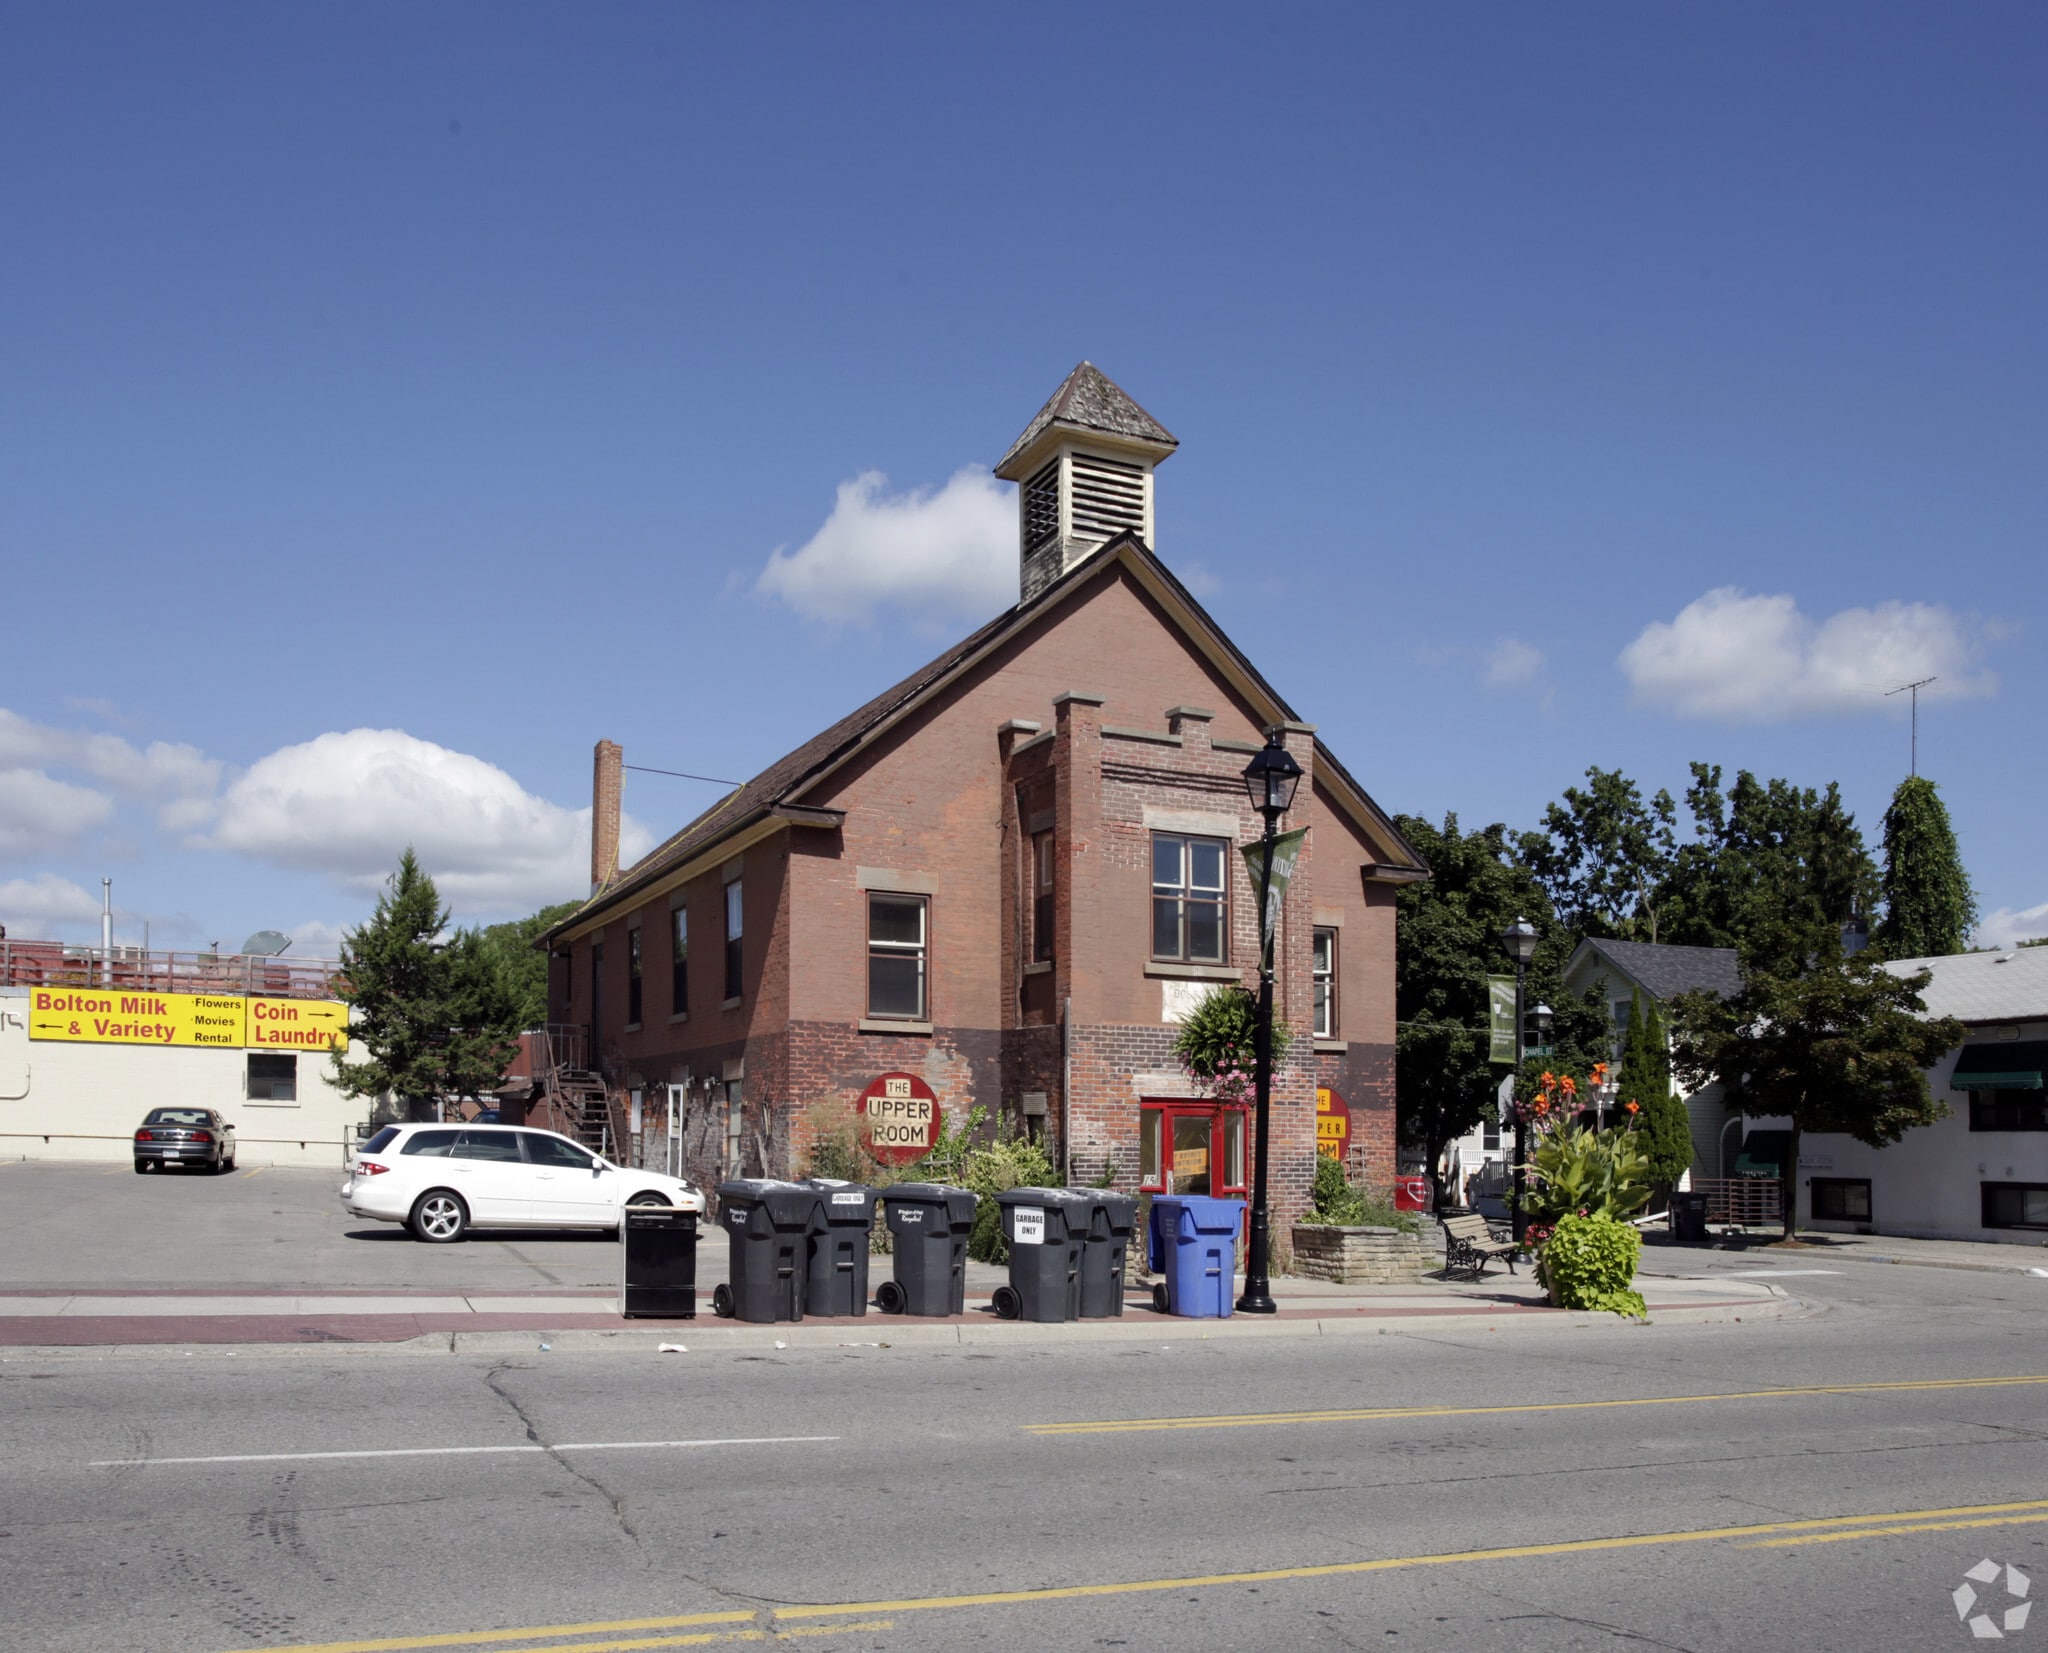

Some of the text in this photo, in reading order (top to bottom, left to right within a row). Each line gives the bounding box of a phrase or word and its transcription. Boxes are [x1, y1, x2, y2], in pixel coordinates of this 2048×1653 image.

[36, 993, 168, 1016] Bolton Milk
[195, 997, 241, 1009] Flowers
[254, 1002, 298, 1021] Coin
[195, 1015, 235, 1026] Movies
[68, 1019, 176, 1043] & Variety
[195, 1032, 232, 1043] Rental
[255, 1025, 338, 1050] Laundry
[1525, 1046, 1553, 1056] CHAPEL ST
[888, 1082, 909, 1094] THE
[1316, 1095, 1326, 1105] HE
[869, 1100, 930, 1119] UPPER
[874, 1125, 924, 1142] ROOM
[1317, 1122, 1341, 1135] PER
[1317, 1143, 1337, 1157] OM
[1015, 1214, 1043, 1224] GARBAGE
[1022, 1226, 1037, 1235] ONLY
